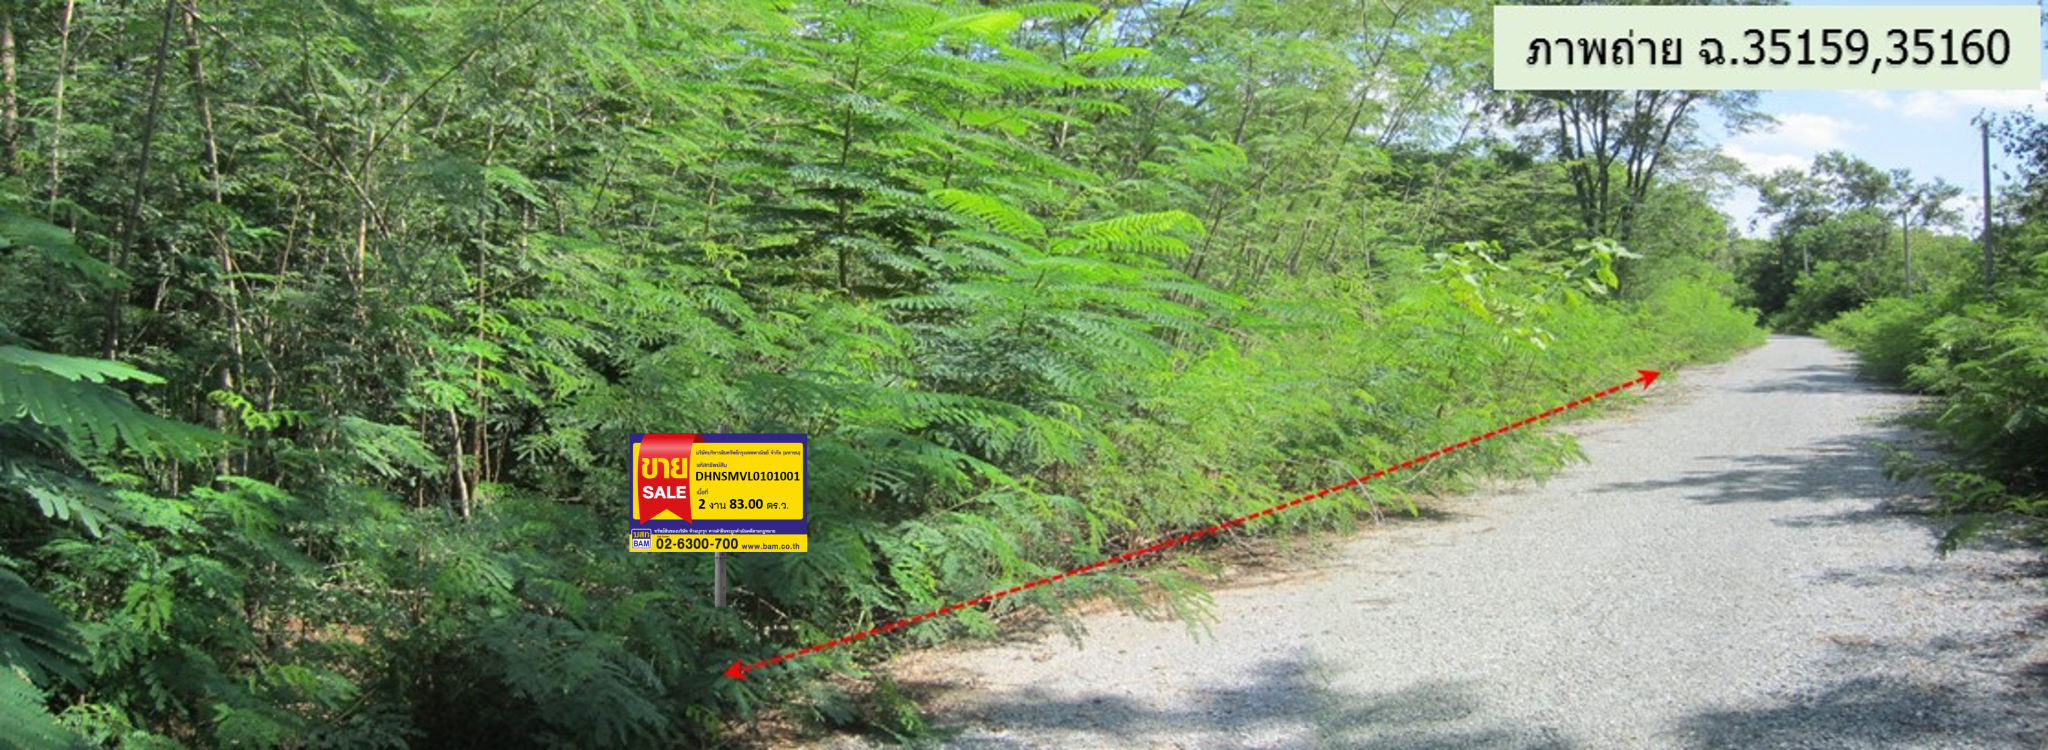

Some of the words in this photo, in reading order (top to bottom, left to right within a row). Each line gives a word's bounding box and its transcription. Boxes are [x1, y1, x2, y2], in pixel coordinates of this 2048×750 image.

[641, 457, 688, 480] ขาย
[695, 471, 800, 482] DHNSMVL0101001
[642, 485, 687, 499] SALE
[698, 498, 706, 510] 2
[708, 501, 727, 510] งาน
[729, 498, 764, 510] 83.00
[766, 501, 789, 510] ตร.ว.
[633, 539, 650, 547] BAM
[656, 538, 739, 550] 02-6300-700
